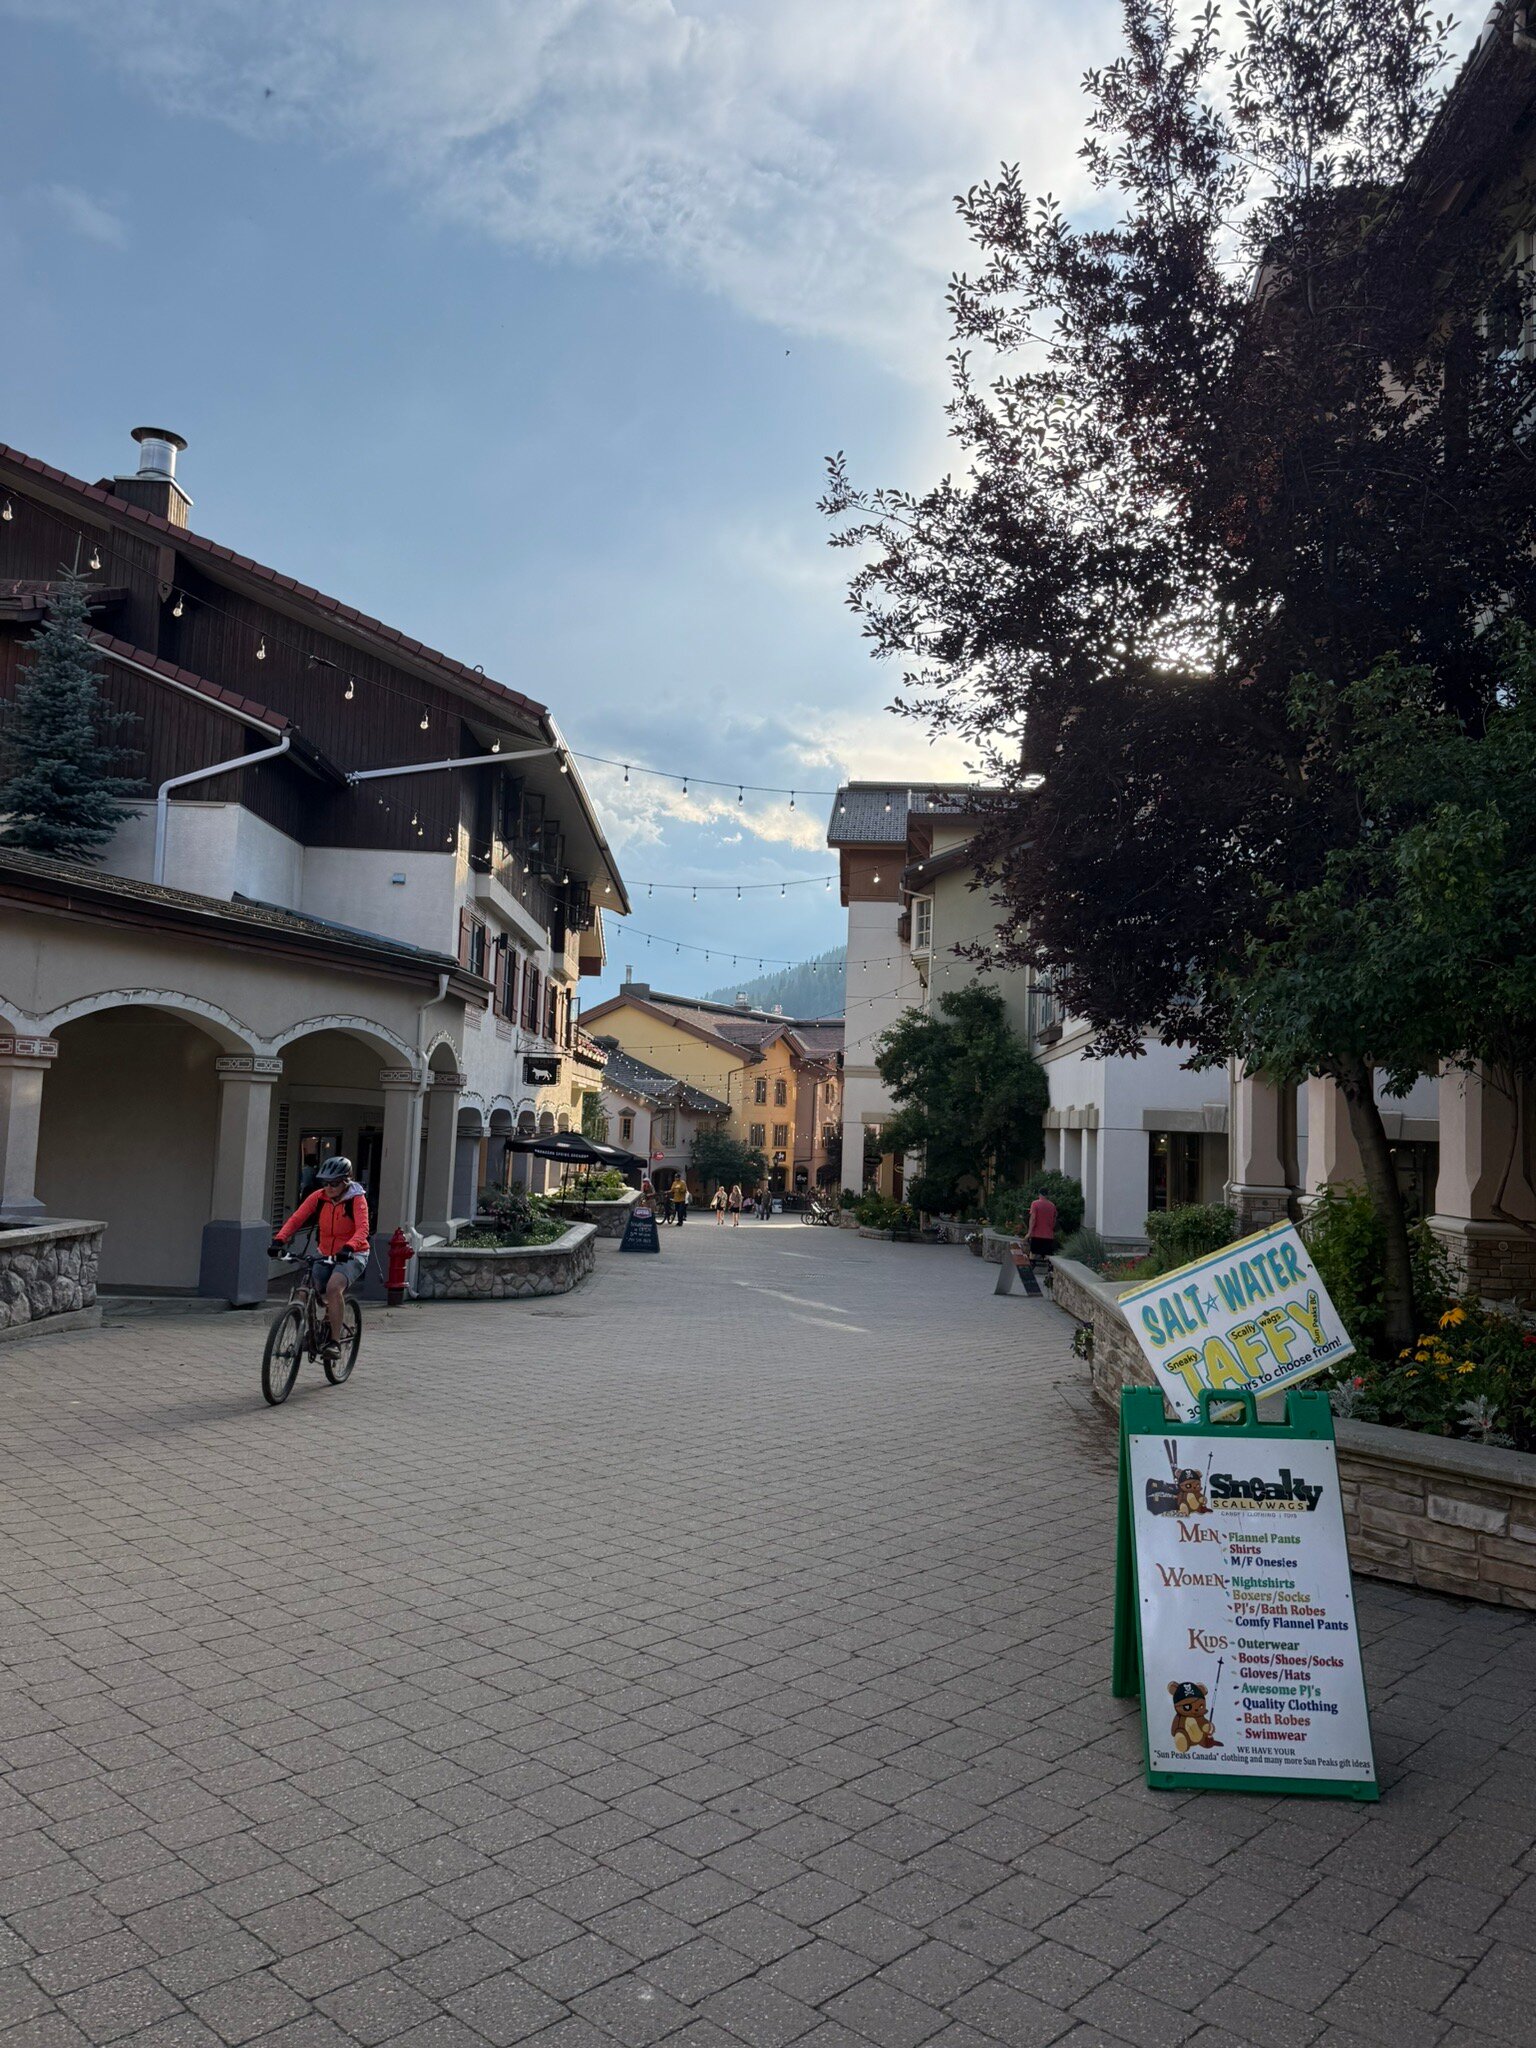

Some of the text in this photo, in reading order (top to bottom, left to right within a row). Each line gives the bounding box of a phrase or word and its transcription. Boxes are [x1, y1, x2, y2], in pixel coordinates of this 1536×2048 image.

[1140, 1242, 1307, 1349] SALT WATER
[1310, 1294, 1317, 1305] BC
[1163, 1289, 1327, 1403] TAFFY
[1167, 1312, 1282, 1372] Sneaky Scally wags
[1258, 1369, 1273, 1384] to
[1274, 1353, 1313, 1378] choose
[1312, 1336, 1342, 1360] from!
[1209, 1469, 1323, 1511] Sneaky
[1213, 1500, 1304, 1510] SCALLYWAGS
[1229, 1533, 1268, 1543] Flannel
[1271, 1534, 1301, 1544] Pants
[1230, 1544, 1261, 1555] Shirts
[1231, 1557, 1297, 1568] M/F Onesies
[1232, 1577, 1295, 1589] Nightshirts
[1232, 1590, 1311, 1603] Boxers/Socks
[1234, 1603, 1326, 1617] PJ's/Bath Robes
[1235, 1617, 1349, 1631] Comfy Flannel Pants
[1238, 1638, 1299, 1651] Outerwear
[1238, 1653, 1344, 1668] Boots/Shoes/Socks
[1240, 1668, 1311, 1681] Gloves/Hats
[1242, 1683, 1321, 1697] Awesome PJ's
[1243, 1698, 1338, 1714] Quality Clothing
[1244, 1714, 1311, 1727] Bath Robes
[1245, 1728, 1307, 1742] Swimwear
[1252, 1747, 1272, 1755] HAVE
[1274, 1748, 1296, 1756] YOUR
[1171, 1751, 1191, 1759] Peaks
[1221, 1753, 1249, 1764] clothing
[1250, 1755, 1263, 1763] and
[1264, 1757, 1283, 1766] many
[1284, 1757, 1302, 1765] more
[1303, 1757, 1317, 1766] Sun
[1317, 1758, 1338, 1767] Peaks
[1339, 1759, 1351, 1769] gift
[1352, 1759, 1371, 1769] ideas
